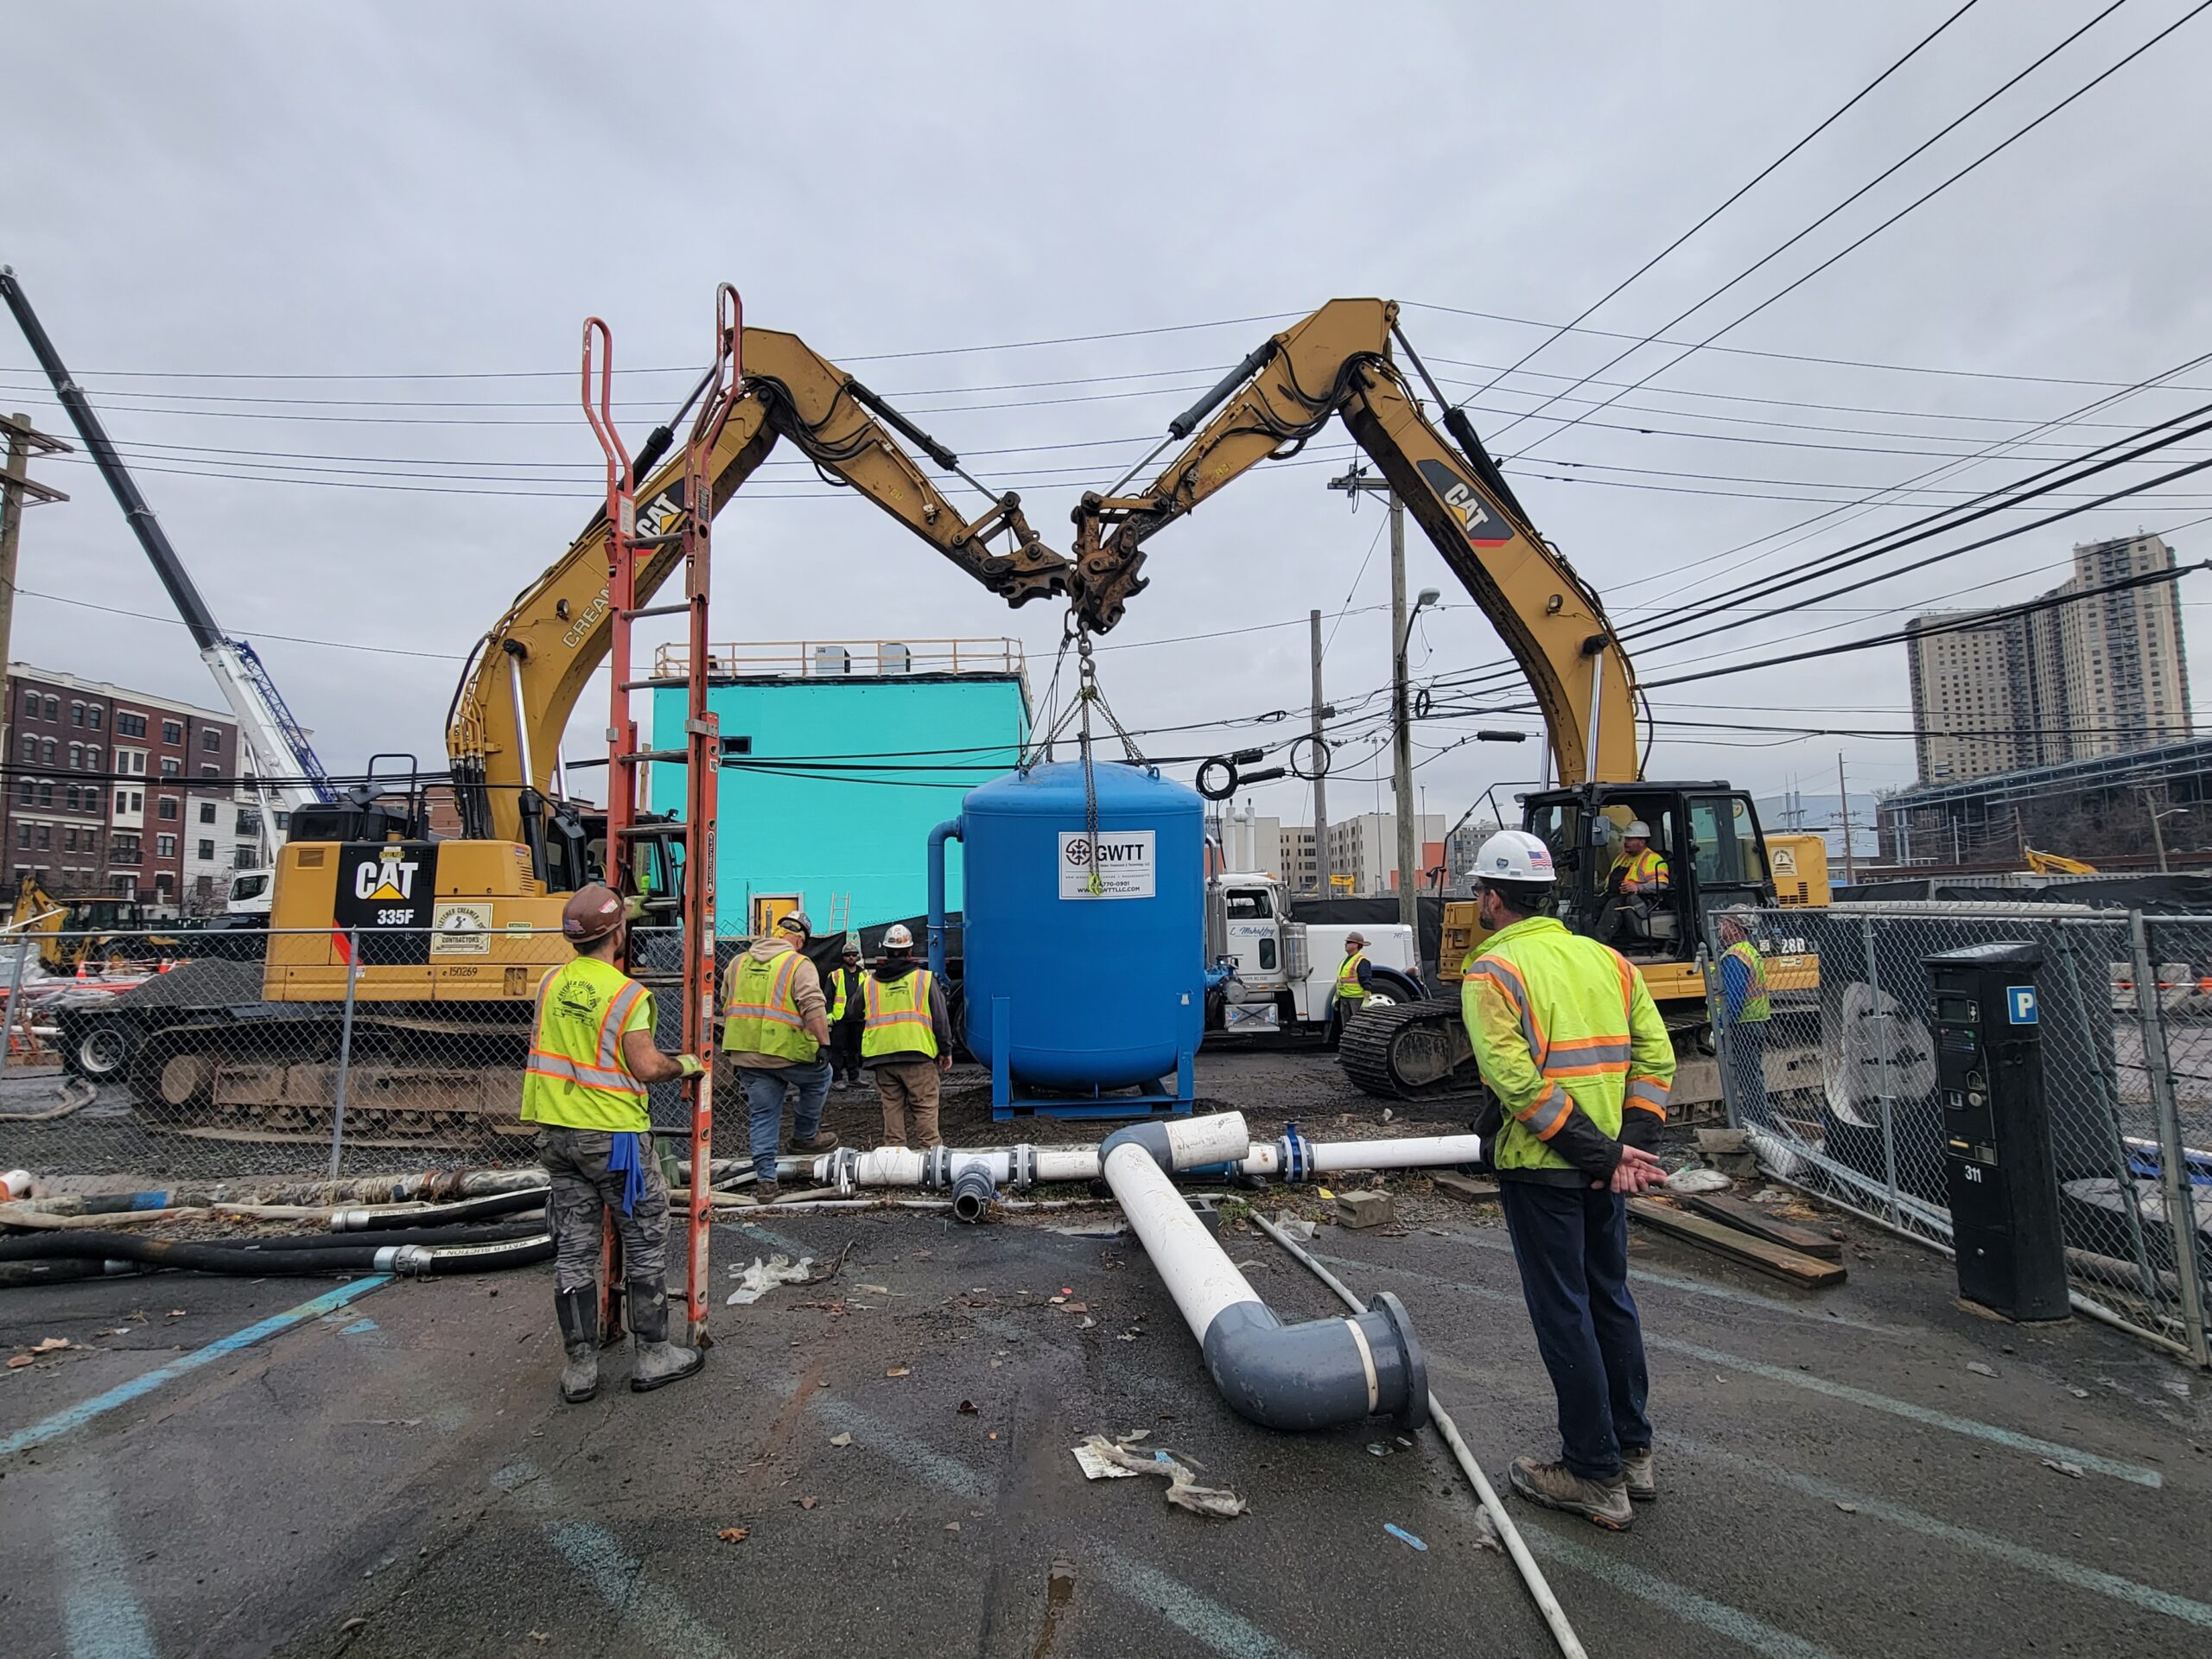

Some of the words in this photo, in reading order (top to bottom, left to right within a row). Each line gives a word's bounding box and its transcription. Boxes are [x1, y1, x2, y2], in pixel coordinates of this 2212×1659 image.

[636, 493, 683, 537] CAT
[1444, 482, 1489, 532] CAT
[1096, 844, 1145, 861] GWTT
[355, 861, 419, 899] CAT
[377, 909, 415, 925] 335F
[2017, 993, 2034, 1018] P
[1964, 1165, 1982, 1183] 311
